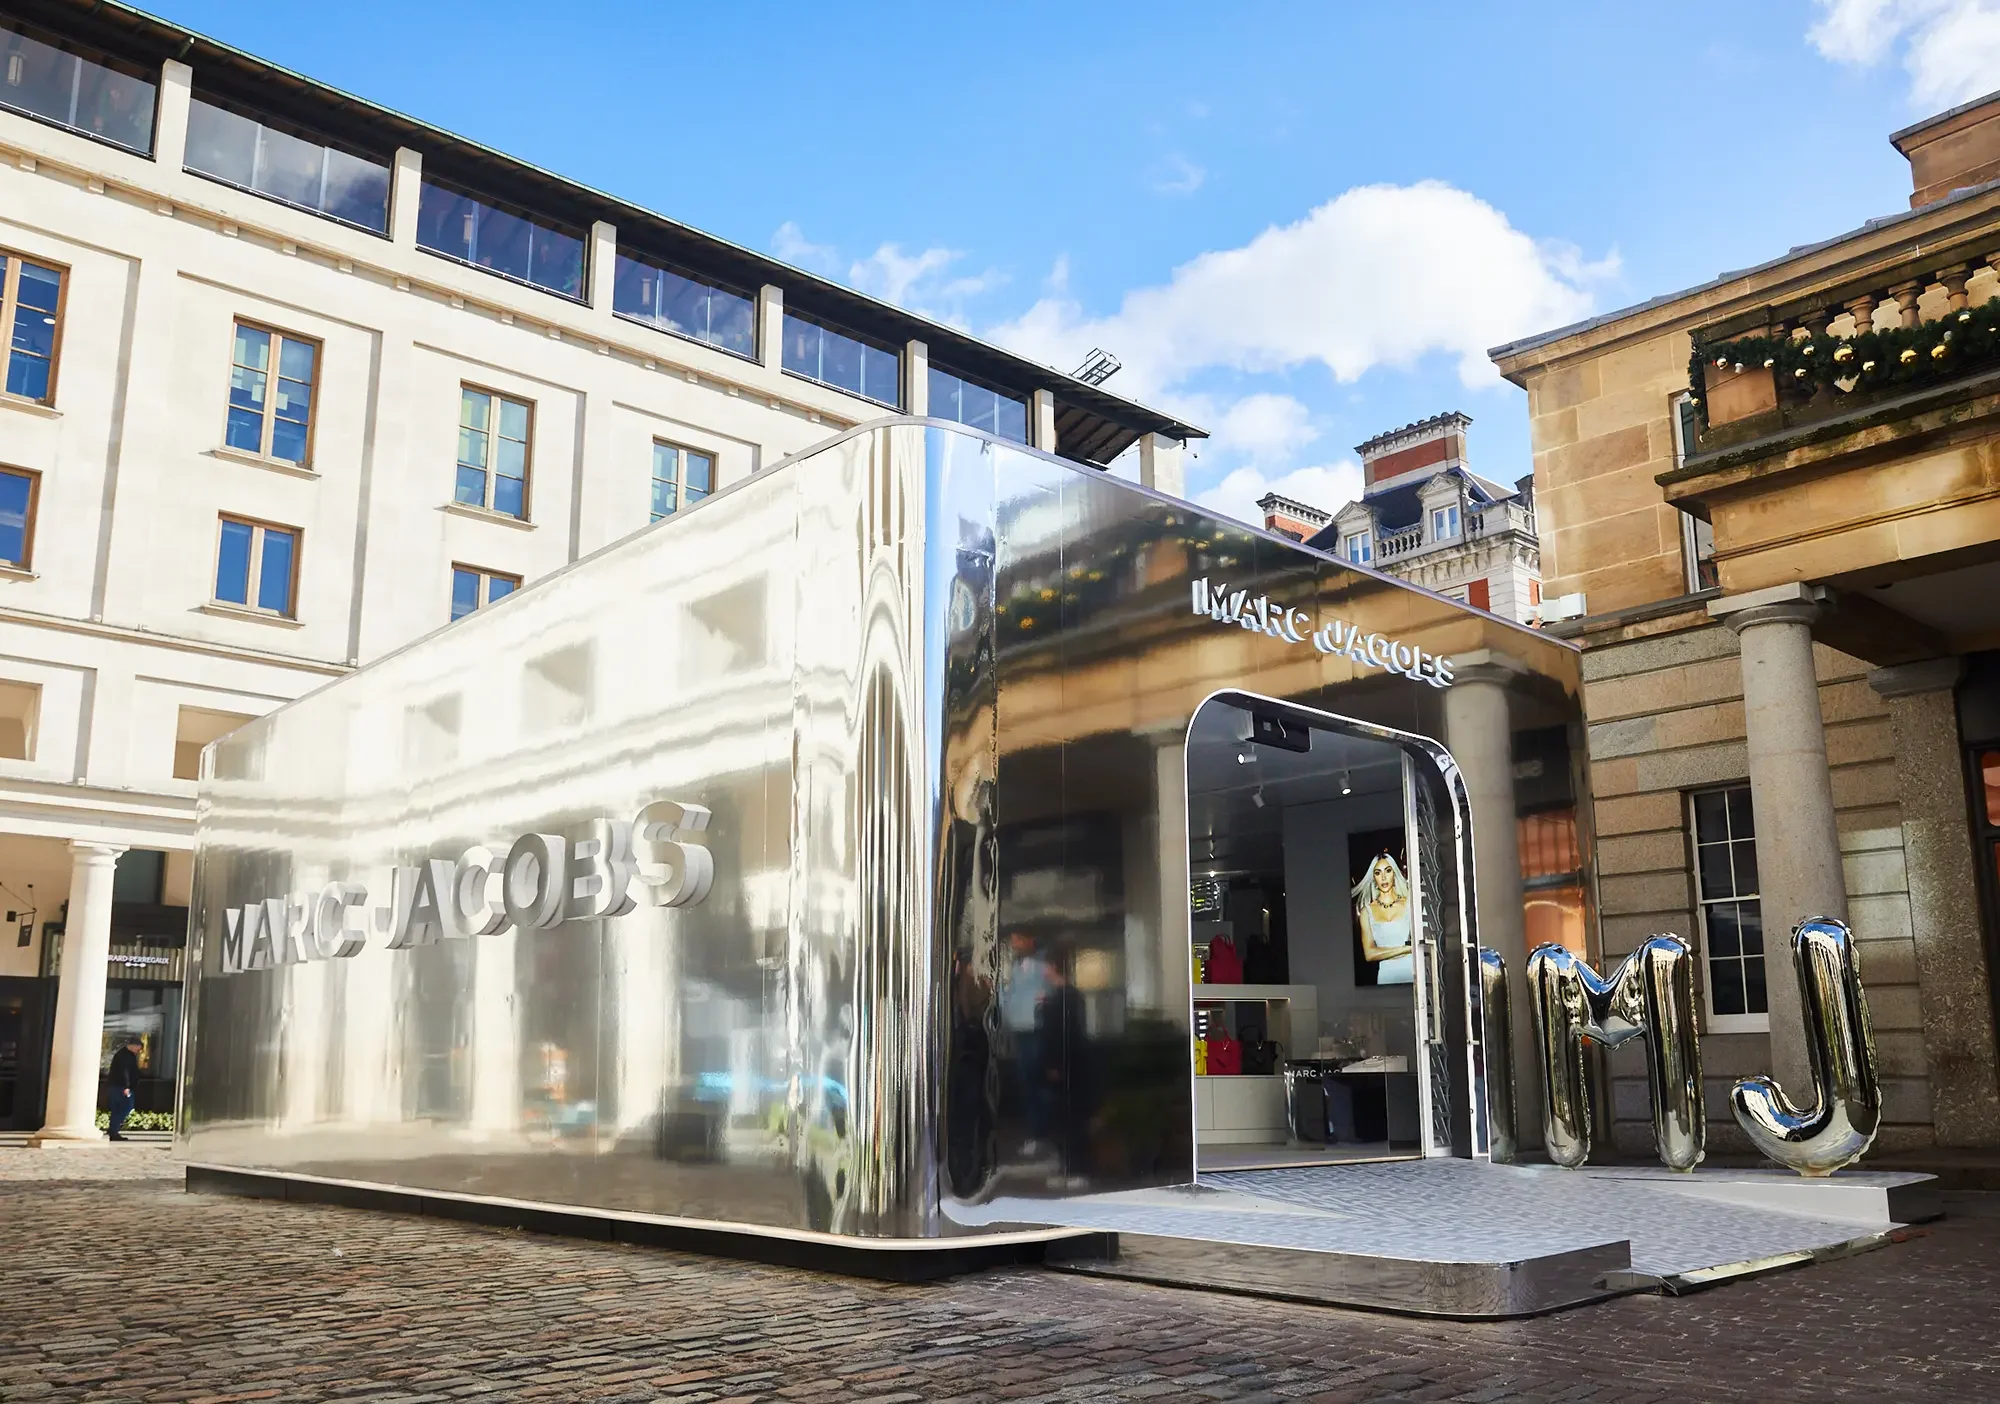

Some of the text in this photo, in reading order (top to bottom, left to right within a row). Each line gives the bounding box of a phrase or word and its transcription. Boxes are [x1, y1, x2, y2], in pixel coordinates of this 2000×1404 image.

[1192, 577, 1455, 688] MARC JACOBS
[222, 800, 714, 974] MARC JACOBS
